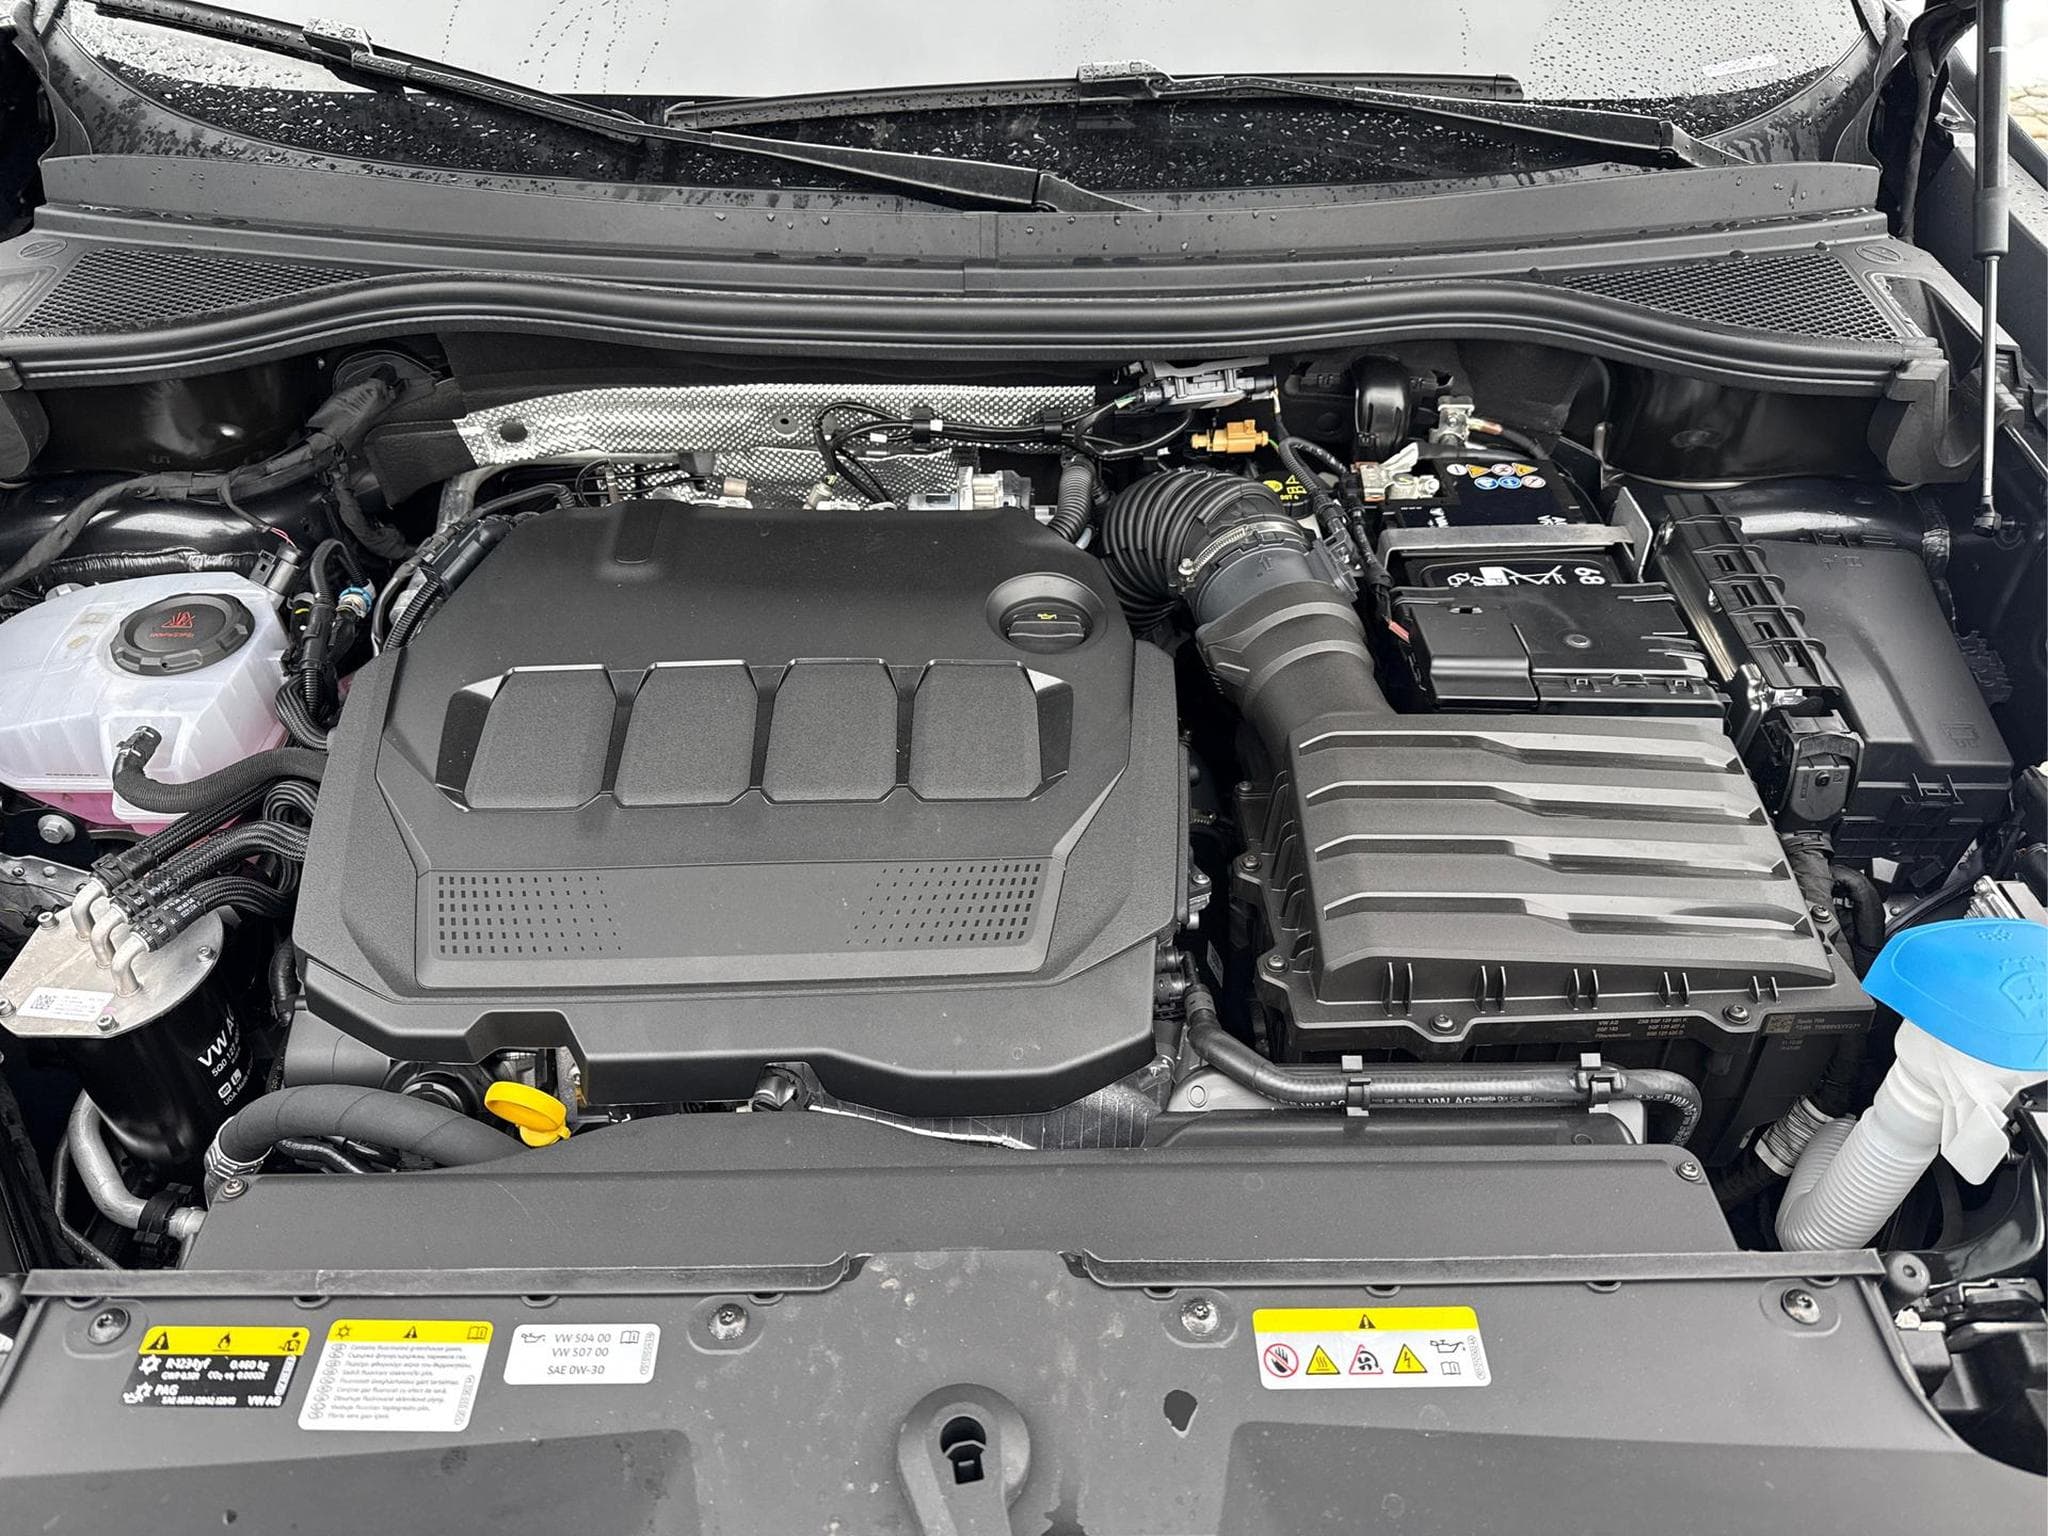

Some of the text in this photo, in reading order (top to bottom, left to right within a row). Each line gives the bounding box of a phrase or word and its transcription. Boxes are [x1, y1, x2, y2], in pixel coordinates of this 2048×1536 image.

[197, 1029, 228, 1067] VW
[554, 1333, 612, 1343] VW 504 00
[552, 1347, 609, 1357] VW 507 00
[547, 1365, 605, 1375] SAE 0W-30
[247, 1395, 265, 1406] VW
[265, 1396, 282, 1406] AG
